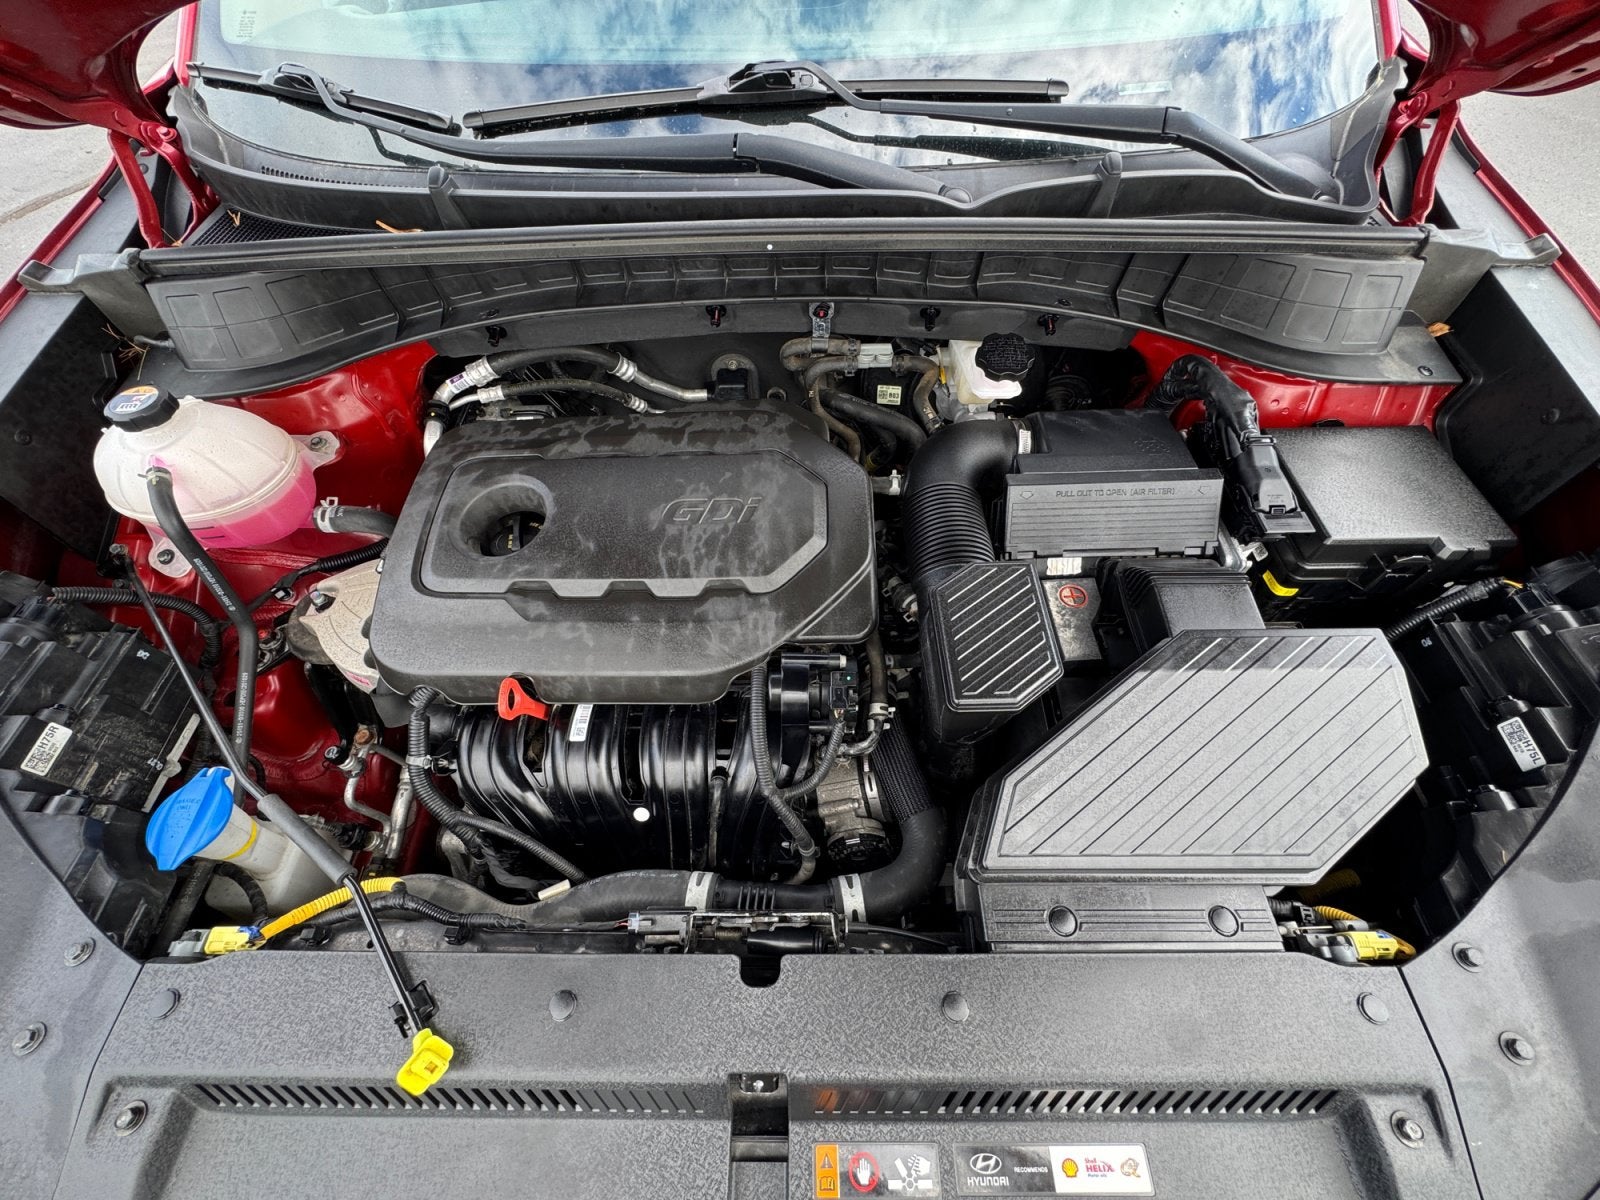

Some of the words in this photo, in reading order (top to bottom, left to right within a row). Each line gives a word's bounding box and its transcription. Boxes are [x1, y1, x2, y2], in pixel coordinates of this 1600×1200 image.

[1055, 490, 1075, 498] PULL
[1076, 489, 1093, 497] OUT
[1094, 489, 1105, 497] TO
[1105, 488, 1127, 496] OPEN
[37, 725, 60, 750] H75R
[1521, 739, 1542, 765] H75L
[1086, 1163, 1115, 1173] HELIX
[967, 1176, 1010, 1187] HYUNDAI
